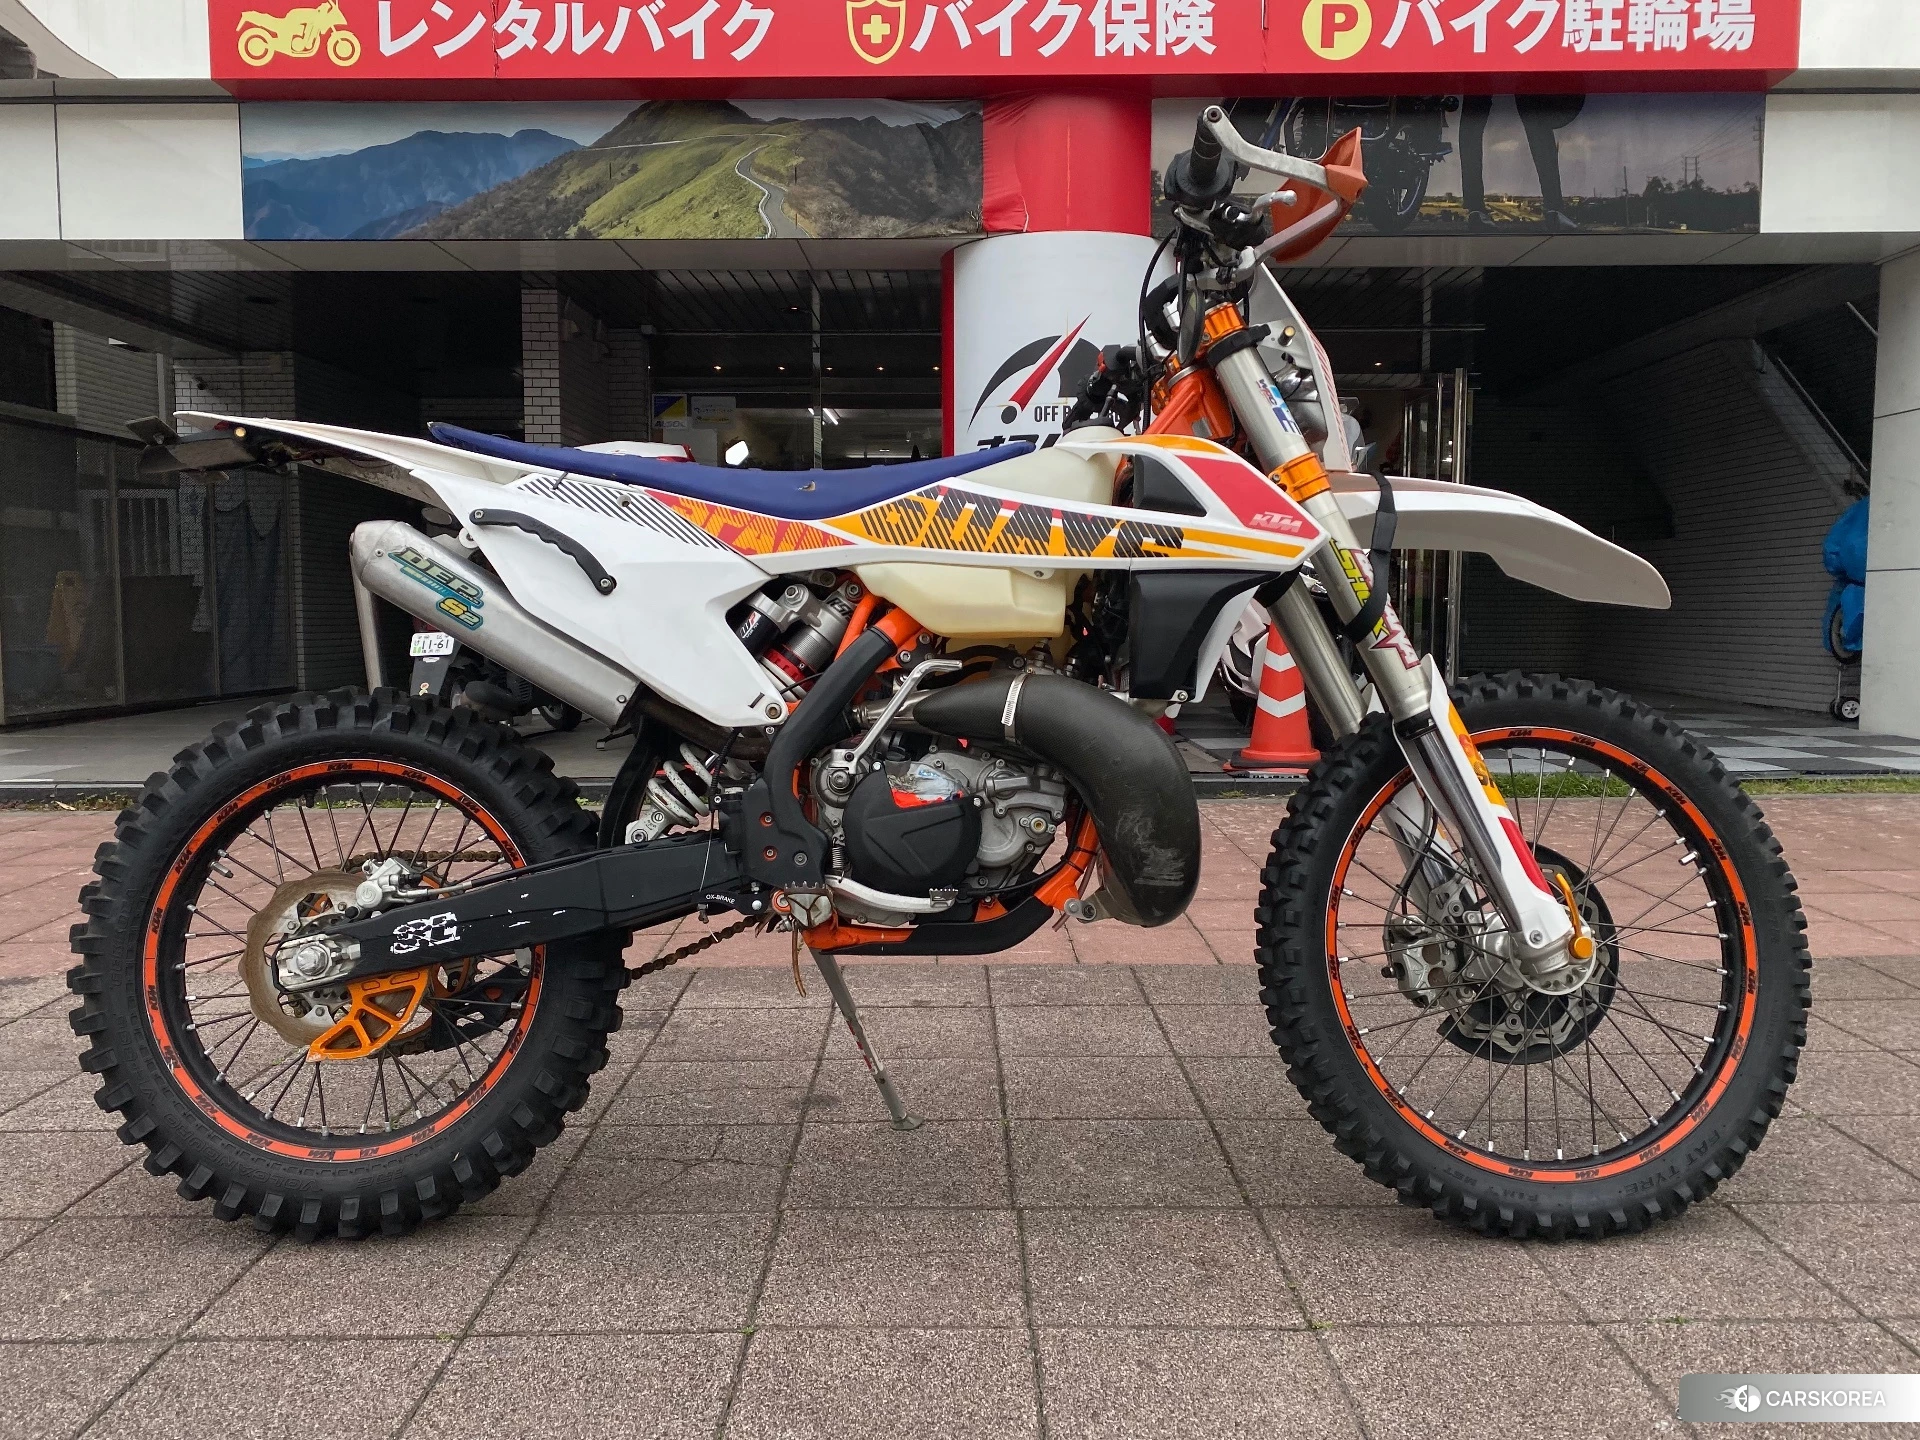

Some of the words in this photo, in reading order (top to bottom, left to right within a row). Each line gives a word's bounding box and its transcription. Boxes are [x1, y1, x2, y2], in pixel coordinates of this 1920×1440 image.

[377, 0, 776, 61] レンタルバイク
[909, 0, 1217, 57] バイク保険
[1381, 0, 1756, 55] バイク駐輪場
[1034, 405, 1059, 422] OFF
[1249, 511, 1303, 534] KTM
[398, 549, 480, 600] DEP
[1508, 730, 1533, 738] KTM
[1571, 735, 1597, 748] KTM
[1665, 785, 1687, 805] KTM
[1709, 837, 1727, 862] KTM
[705, 893, 736, 905] OX-BRAKE
[1687, 1130, 1720, 1166] FAT
[1623, 1168, 1681, 1196] TYRE
